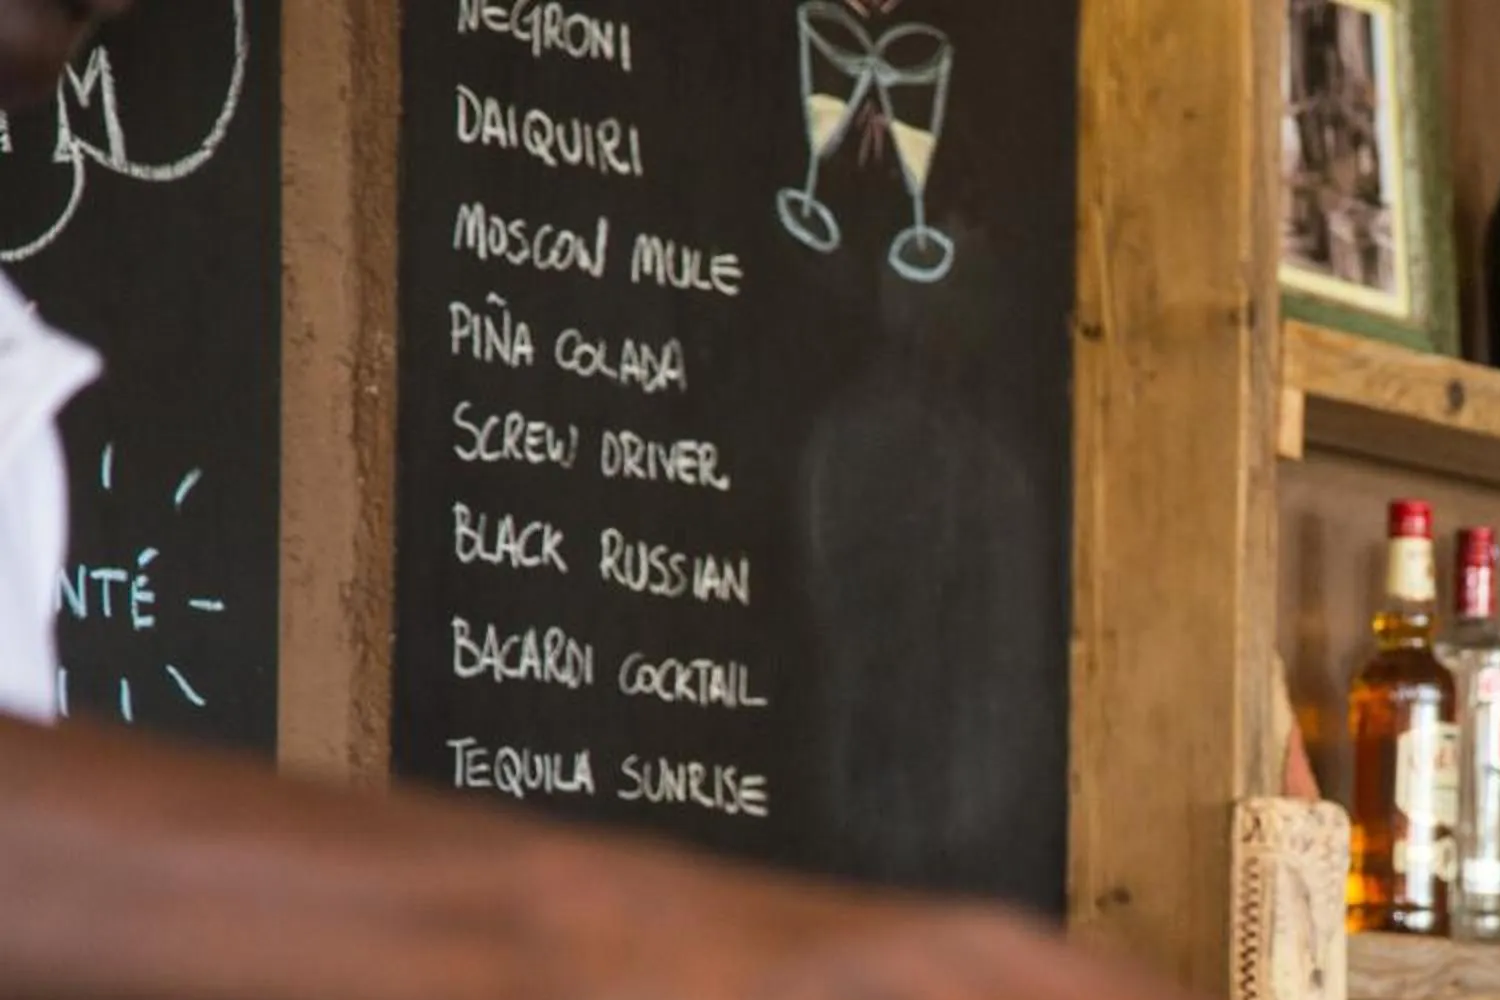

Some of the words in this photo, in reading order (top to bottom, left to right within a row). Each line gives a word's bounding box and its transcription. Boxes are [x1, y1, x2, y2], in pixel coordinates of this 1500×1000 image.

[457, 0, 632, 71] NEGRONI
[456, 84, 643, 175] DAIQUIRI
[453, 202, 608, 278] MOSCOW
[631, 233, 743, 296] MULE
[449, 292, 534, 367] PIÑA
[554, 328, 686, 393] COLADA
[453, 401, 578, 467] SCREW
[601, 430, 730, 491] DRIVER
[59, 547, 159, 630] NTÉ
[452, 502, 568, 572] BLACK
[599, 527, 749, 604] RUSSIAN
[451, 616, 593, 689] BACARDI
[619, 653, 767, 707] COCKTAIL
[447, 737, 595, 798] TEQUILA
[618, 755, 768, 817] SUNRISE
